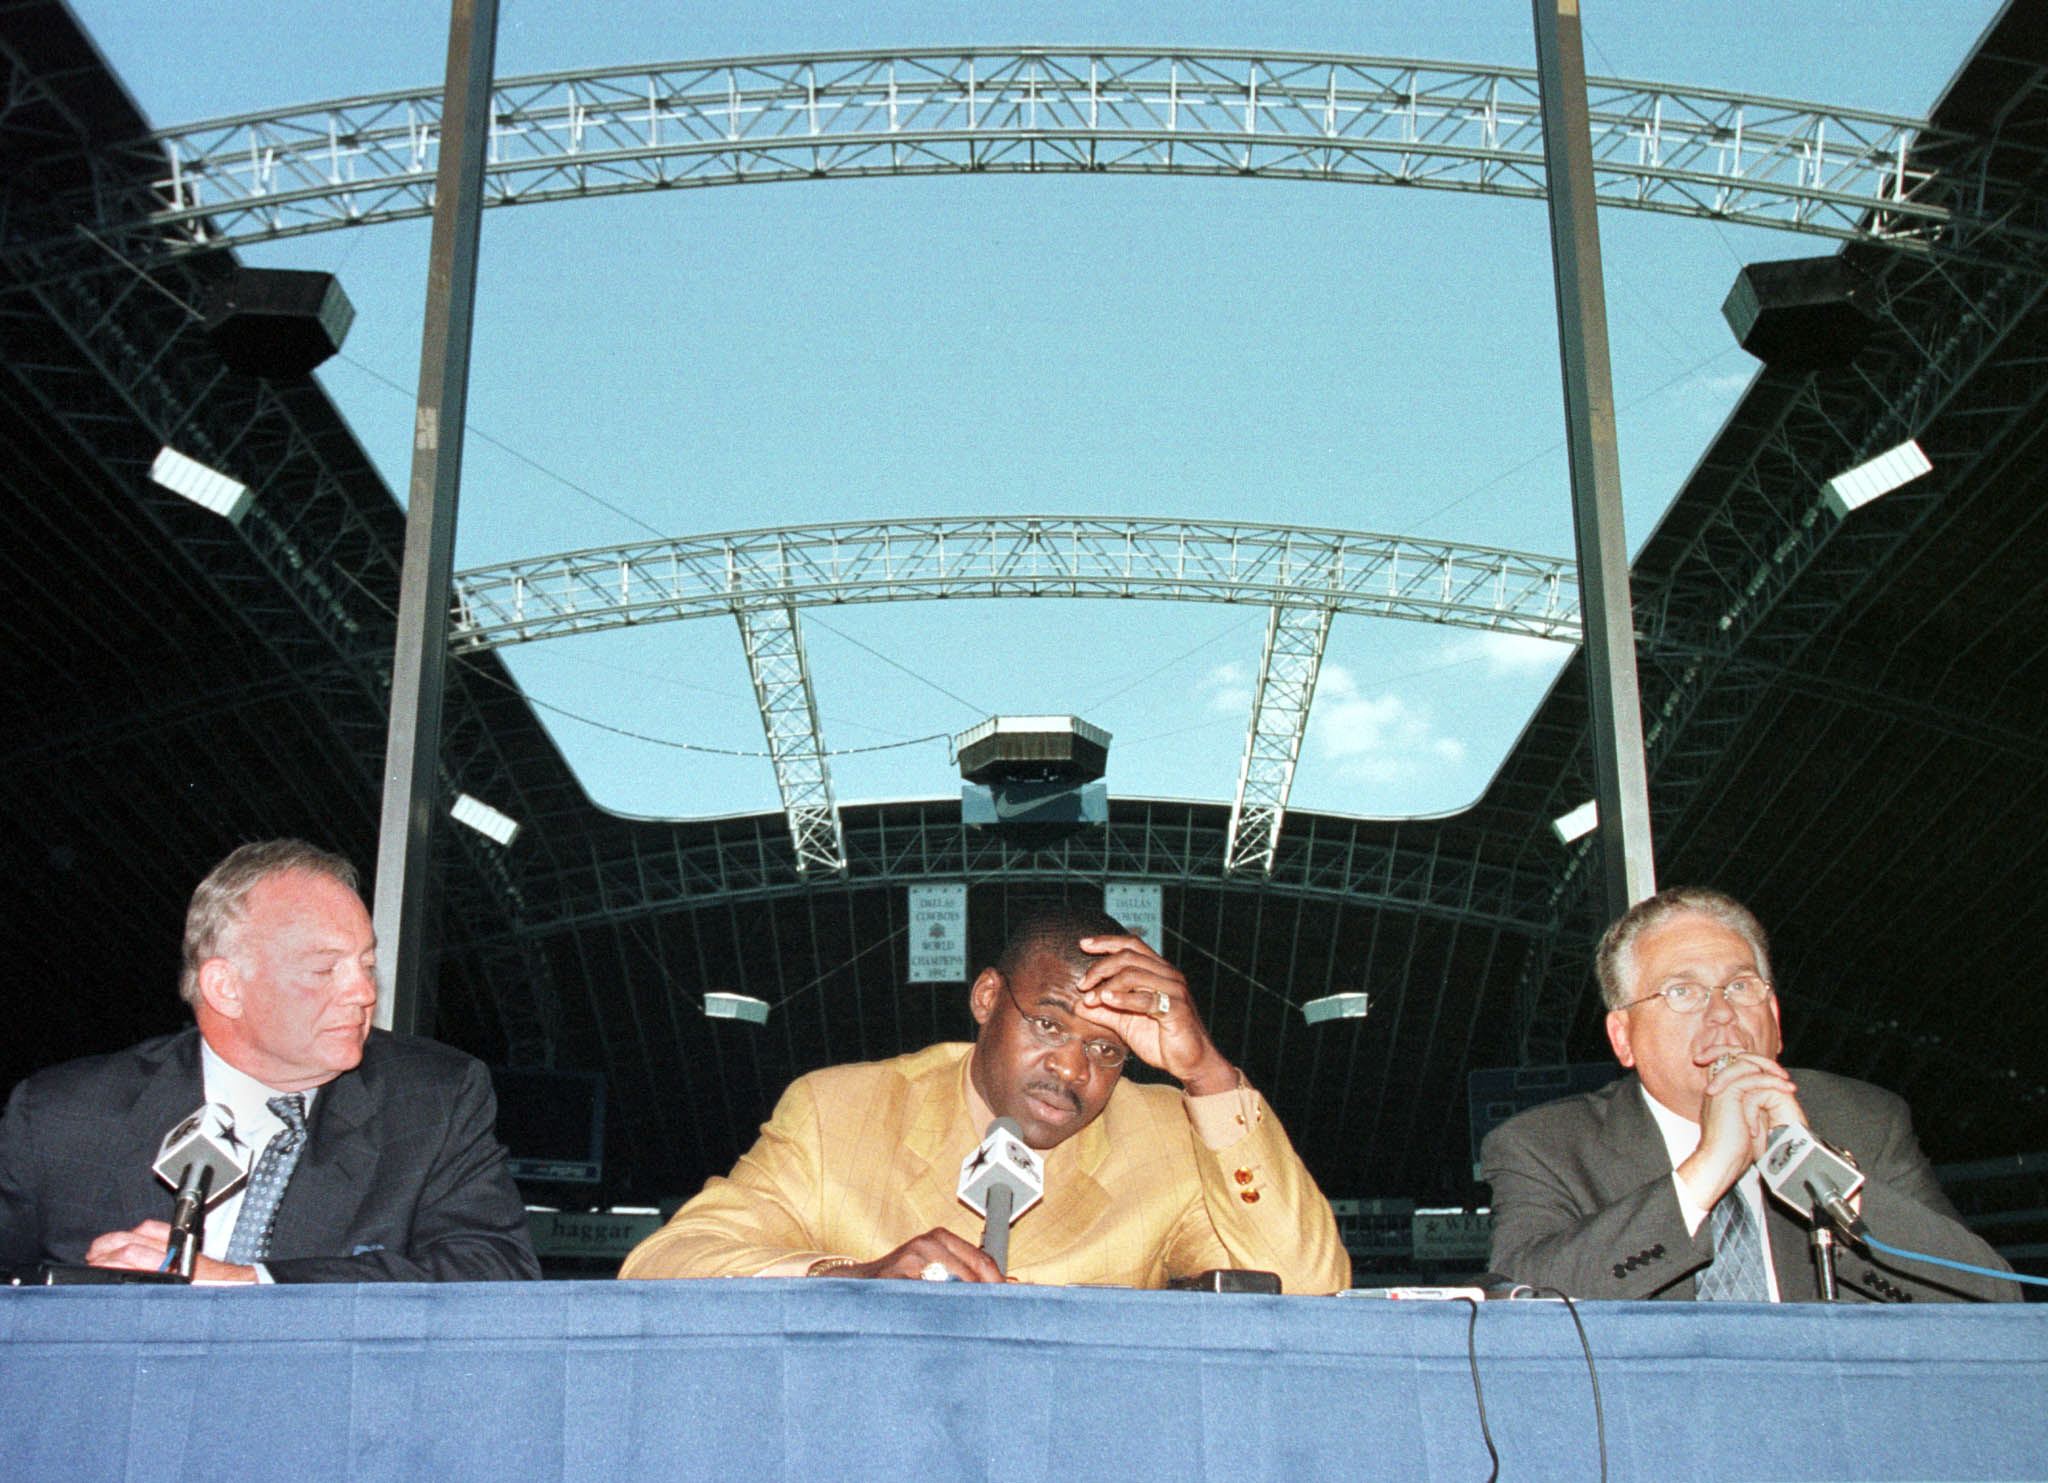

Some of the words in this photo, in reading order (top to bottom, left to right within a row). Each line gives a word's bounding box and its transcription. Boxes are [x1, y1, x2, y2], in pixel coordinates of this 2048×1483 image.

[920, 899, 954, 908] DALLAS
[1116, 899, 1152, 908] DALLAS
[916, 912, 959, 921] COWBOYS
[921, 941, 955, 951] WORLD
[552, 1217, 633, 1242] haggar
